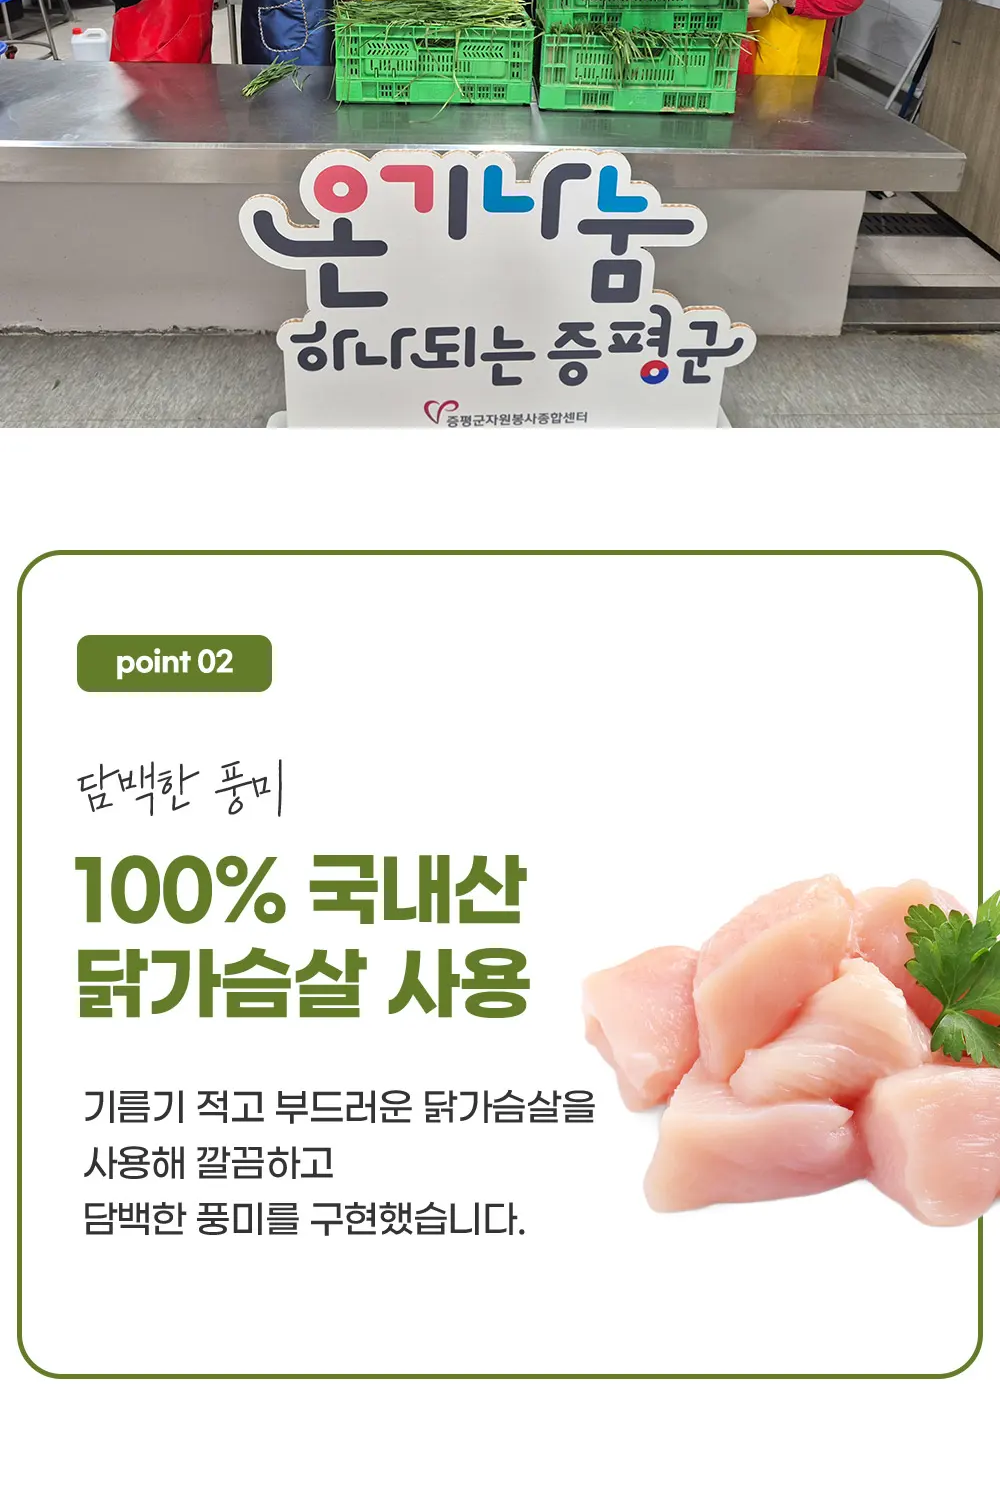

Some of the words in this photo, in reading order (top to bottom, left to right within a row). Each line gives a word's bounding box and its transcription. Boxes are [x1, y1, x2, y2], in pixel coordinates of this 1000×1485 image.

[253, 164, 695, 309] 온기나눔
[290, 320, 537, 387] 하나되는
[547, 304, 745, 386] 증평군
[446, 411, 588, 428] 증평군자원봉사종합센터
